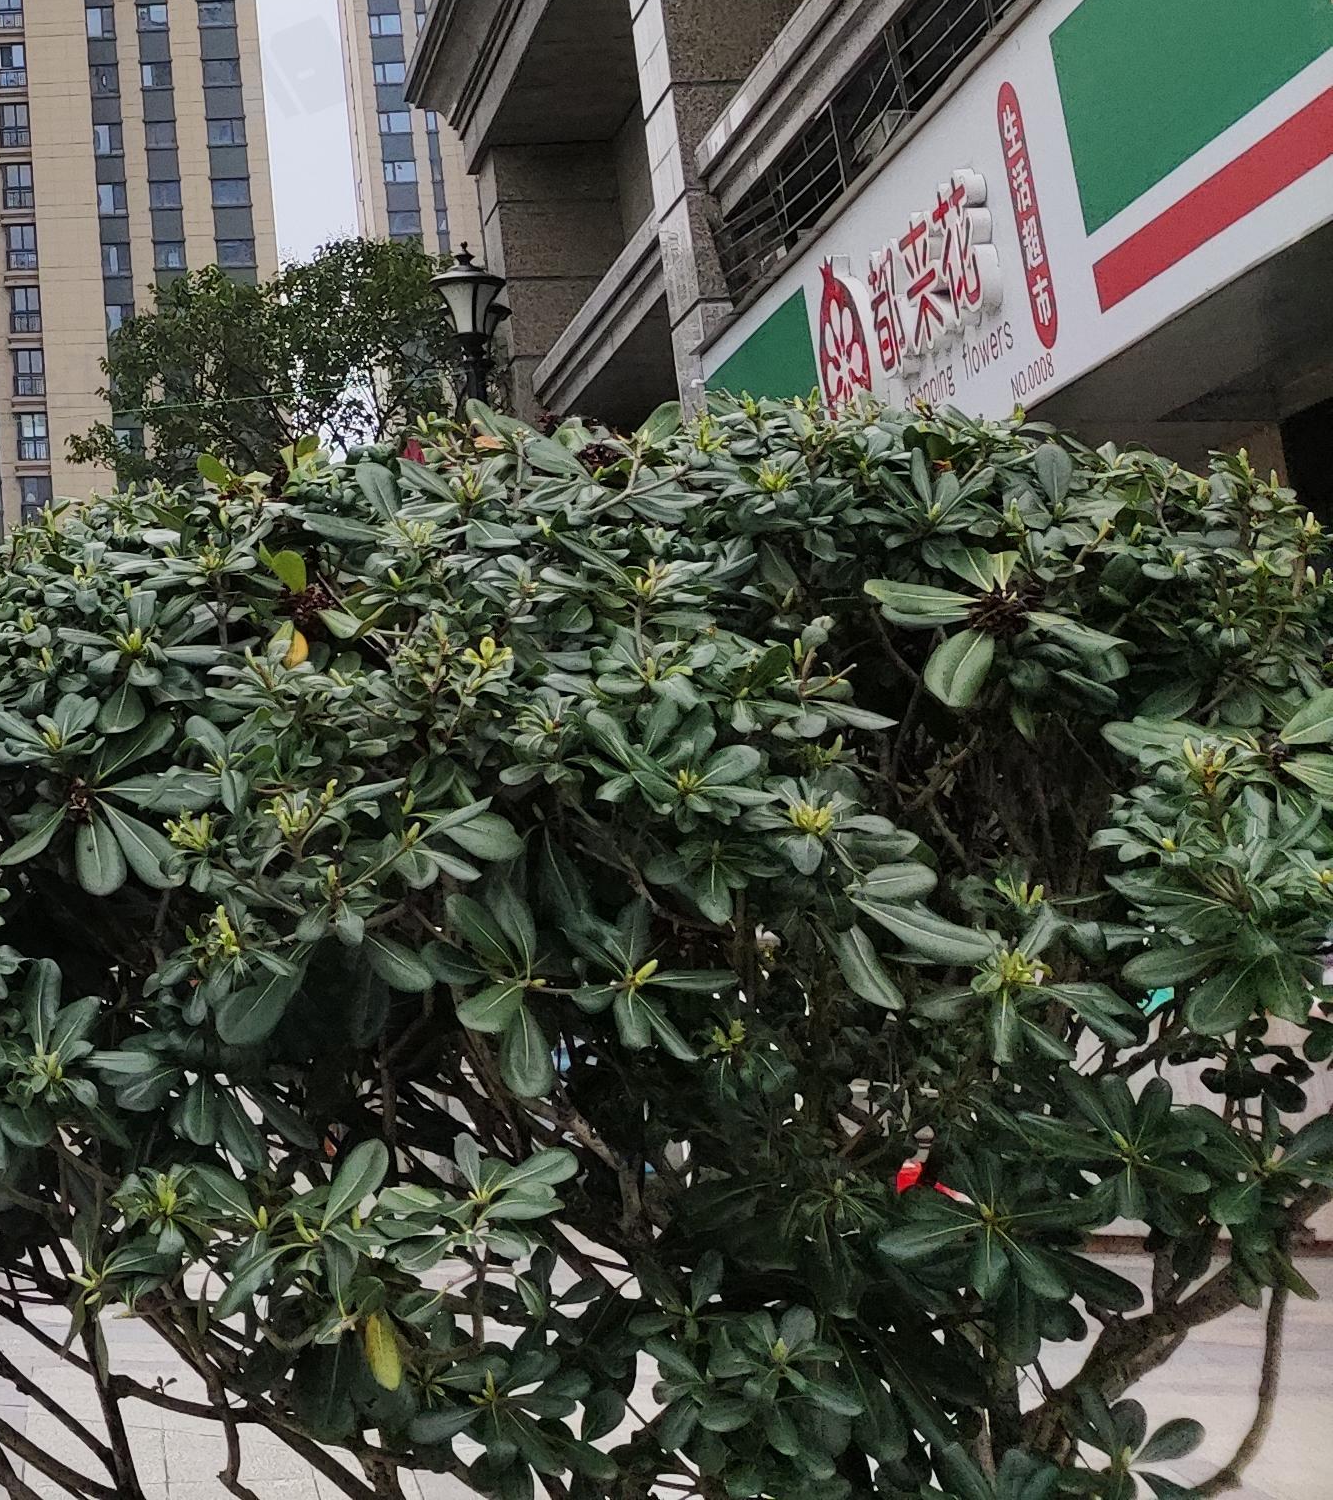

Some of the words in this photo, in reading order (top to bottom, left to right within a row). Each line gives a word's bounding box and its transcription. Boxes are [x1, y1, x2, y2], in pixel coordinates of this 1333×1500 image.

[867, 184, 982, 372] 都来花
[1001, 105, 1054, 327] 生活超市
[962, 321, 1014, 381] flowers
[1010, 353, 1055, 401] NO.0008
